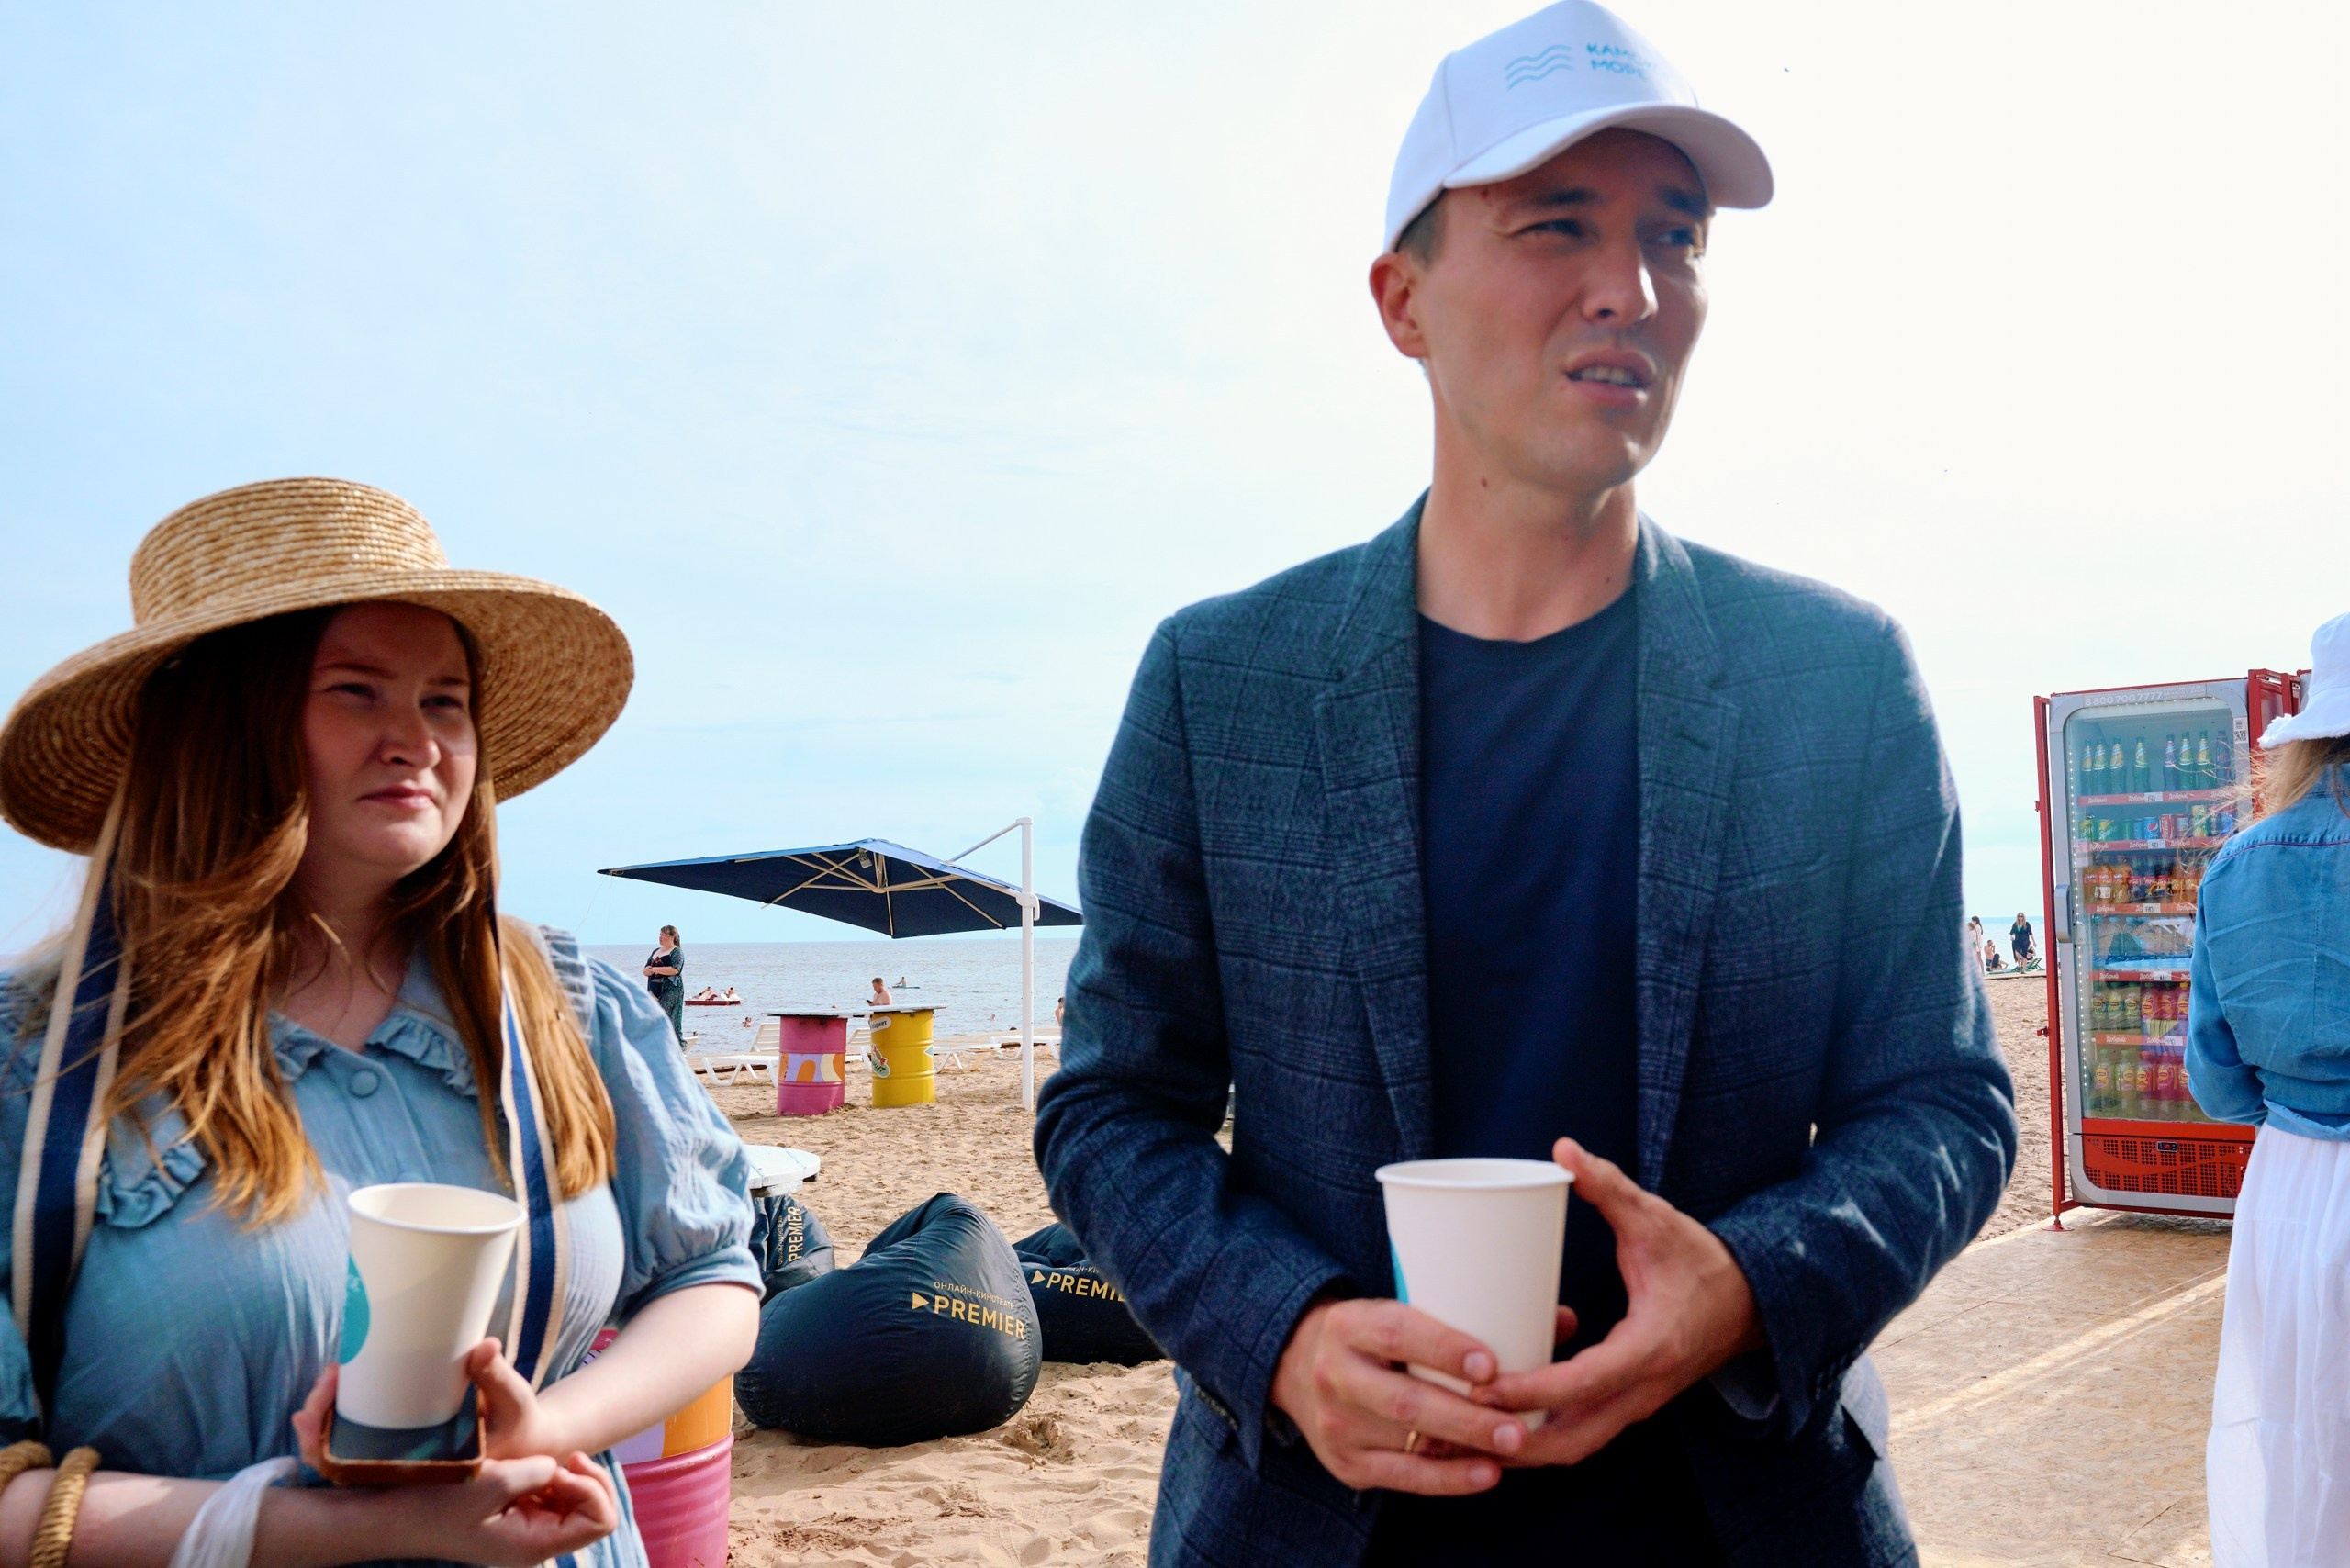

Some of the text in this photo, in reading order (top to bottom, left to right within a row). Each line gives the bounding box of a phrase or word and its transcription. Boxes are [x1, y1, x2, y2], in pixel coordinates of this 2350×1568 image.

[2085, 697, 2092, 706] 8
[2093, 696, 2114, 705] 800
[2116, 694, 2136, 704] 700
[2137, 691, 2163, 701] 7777
[2088, 796, 2108, 804] Добрый
[2168, 792, 2189, 801] Добрый
[788, 1206, 803, 1262] PREMIER
[934, 1281, 1015, 1309] ОНЛАЙН-КИНОТЕАТР
[934, 1294, 1025, 1340] PREMIER
